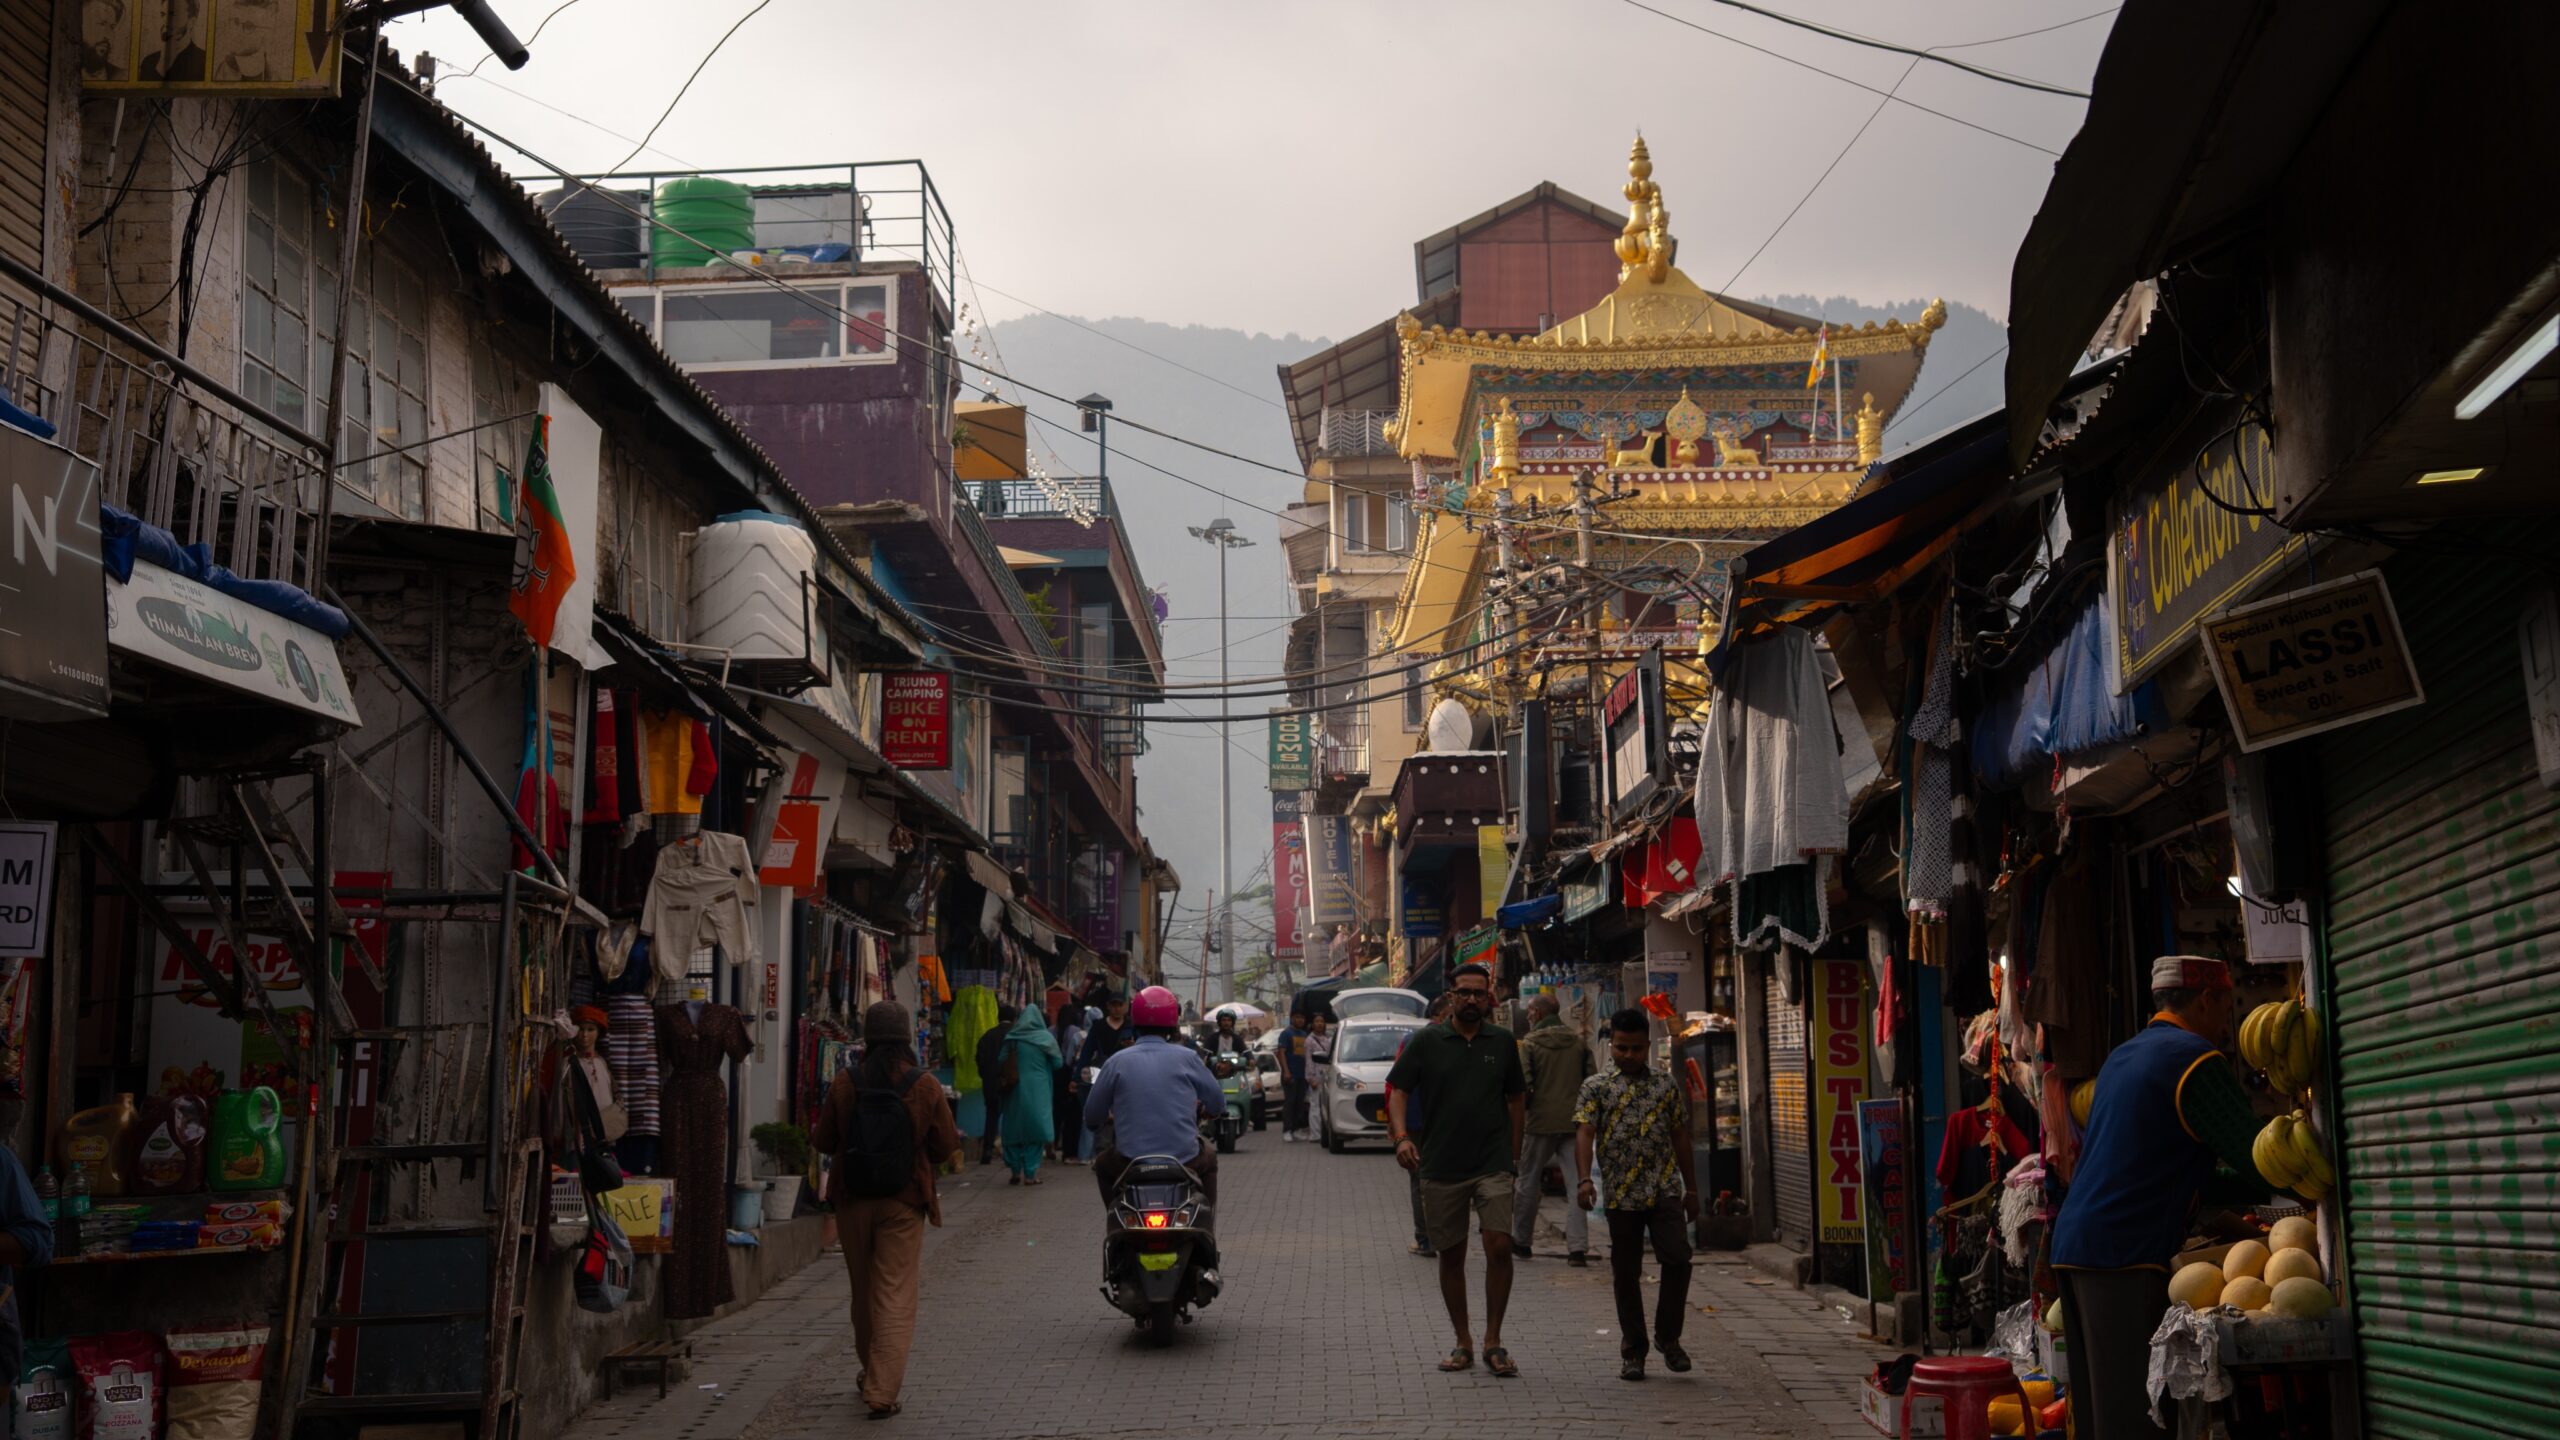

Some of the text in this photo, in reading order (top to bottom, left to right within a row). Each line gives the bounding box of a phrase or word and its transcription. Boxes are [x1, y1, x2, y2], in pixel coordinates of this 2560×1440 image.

[13, 483, 57, 577] N
[2149, 452, 2240, 614] Collection
[2219, 619, 2273, 643] Special
[2279, 606, 2333, 628] Kulhad
[225, 643, 259, 665] BREW
[2232, 613, 2383, 684] LASSI
[893, 677, 938, 687] TRIUND
[2255, 657, 2384, 703] Sweet & Salt
[886, 688, 944, 699] CAMPING
[888, 701, 940, 715] BIKE
[901, 717, 926, 728] ON
[885, 730, 942, 745] RENT
[1322, 817, 1338, 870] HOTEL
[1825, 961, 1863, 1222] BUS TAXI
[614, 1195, 655, 1223] ALE
[1824, 1226, 1865, 1241] BOOKIN
[107, 1387, 142, 1396] INDIA
